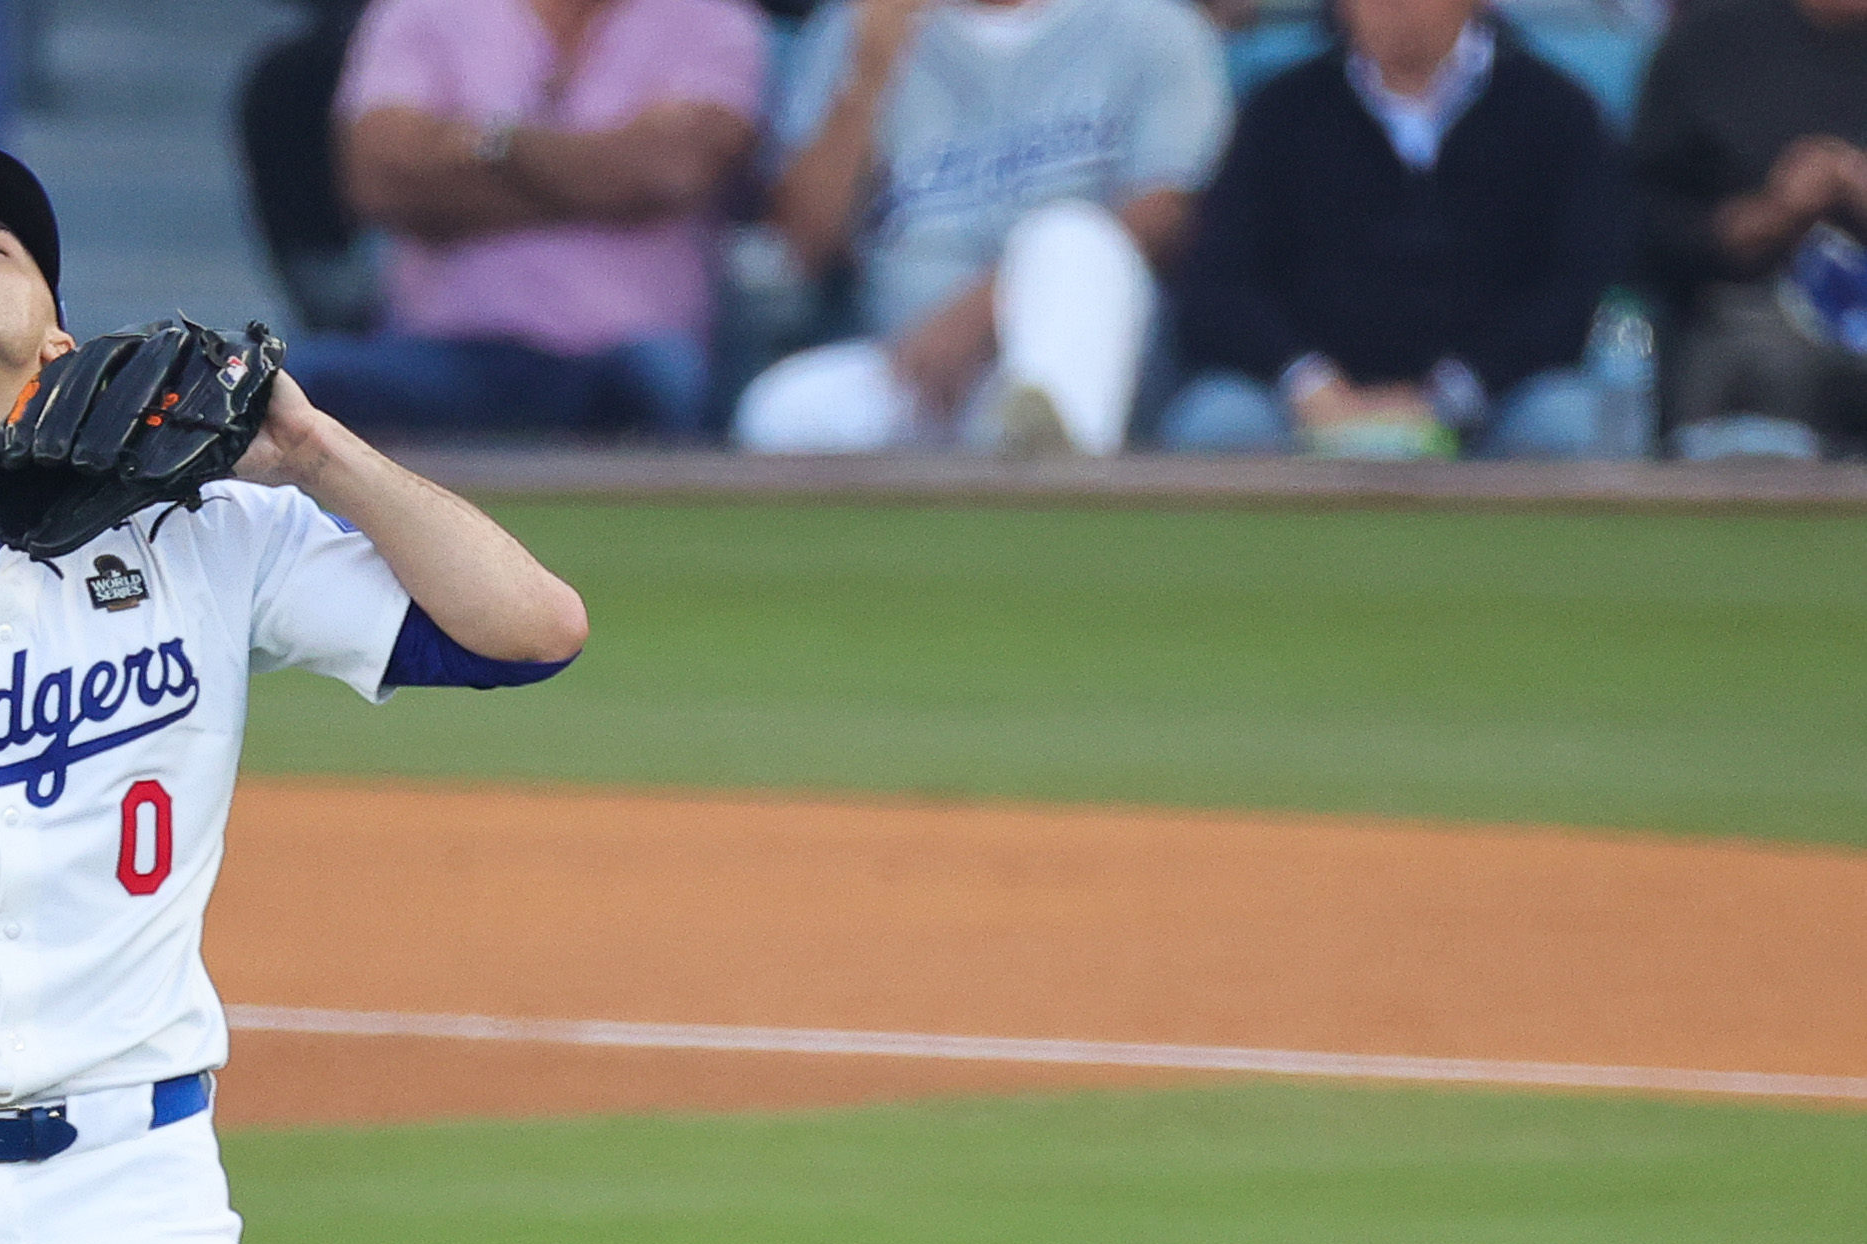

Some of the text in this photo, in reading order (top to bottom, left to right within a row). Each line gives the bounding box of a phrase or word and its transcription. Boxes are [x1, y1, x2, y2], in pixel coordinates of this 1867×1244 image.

[90, 574, 142, 592] WORLD
[95, 585, 144, 602] SERIES
[116, 779, 173, 897] 0
